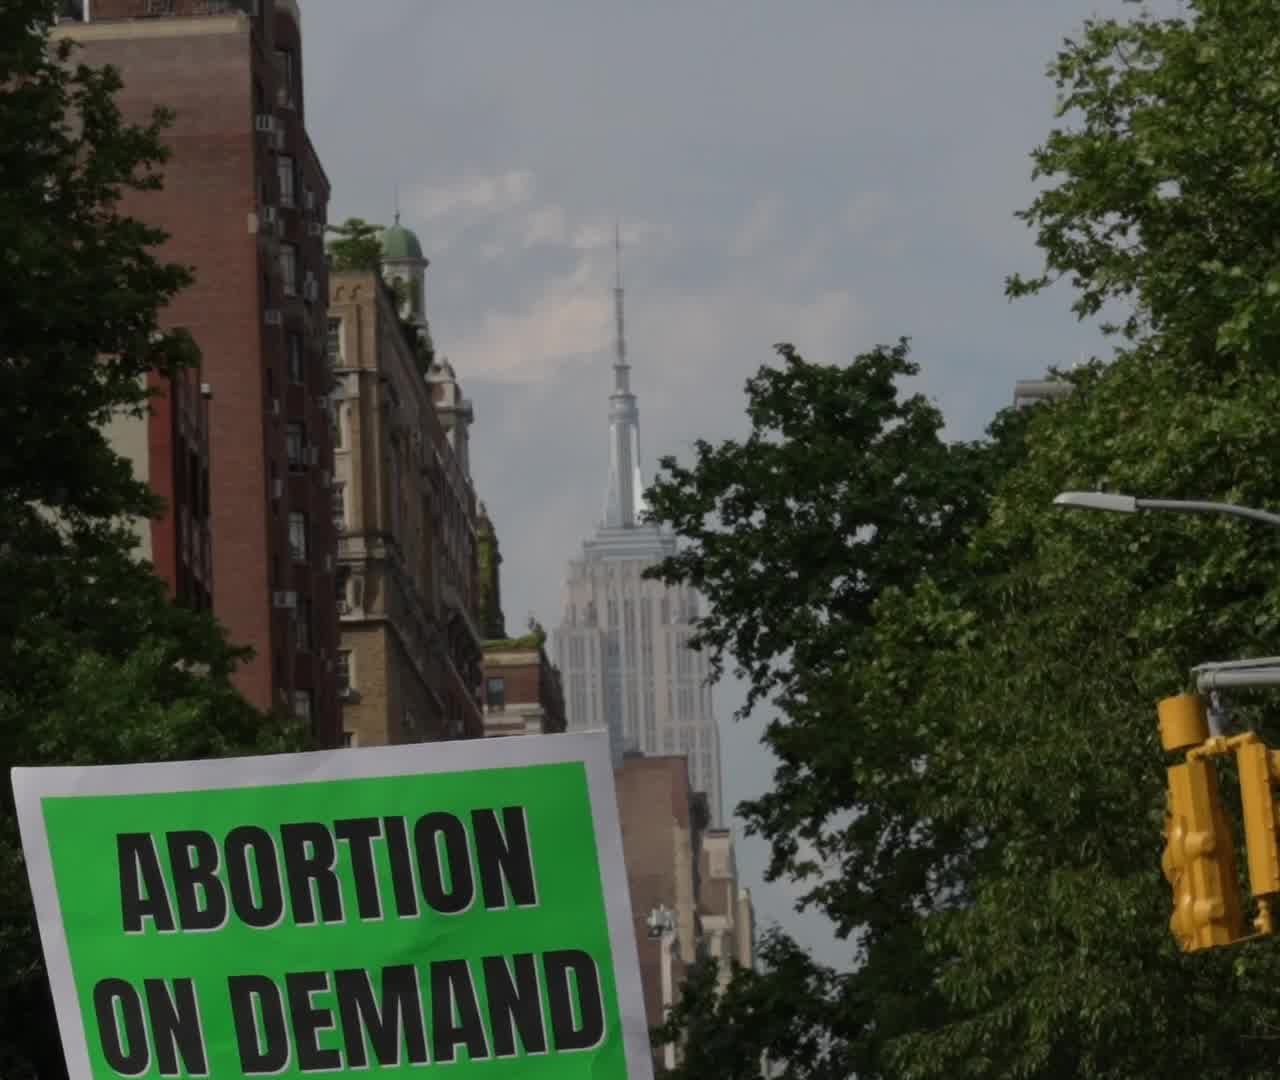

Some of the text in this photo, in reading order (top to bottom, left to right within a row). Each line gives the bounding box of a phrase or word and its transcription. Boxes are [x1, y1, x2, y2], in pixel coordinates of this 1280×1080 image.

[117, 805, 538, 934] ABORTION
[93, 949, 605, 1077] ON DEMAND
